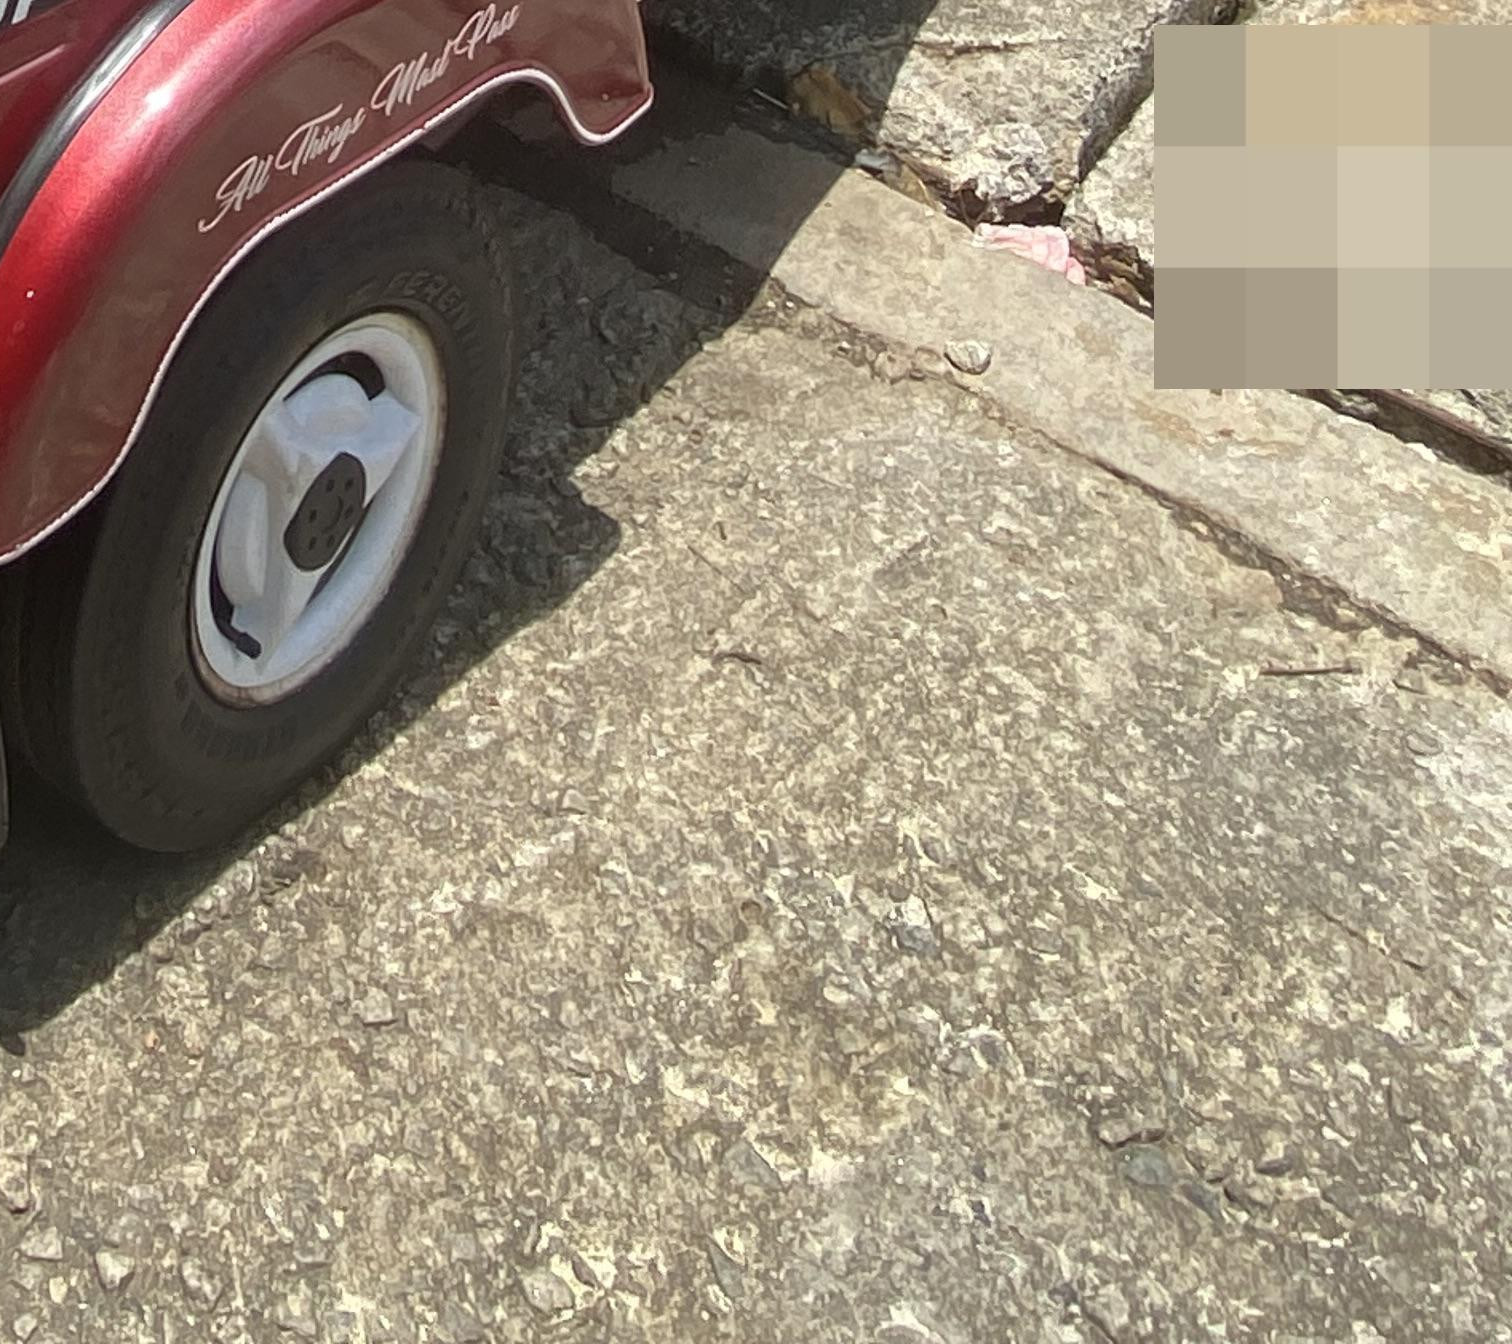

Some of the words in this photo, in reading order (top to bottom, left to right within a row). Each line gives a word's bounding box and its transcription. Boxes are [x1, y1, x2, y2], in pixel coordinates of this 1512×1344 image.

[198, 154, 274, 233] All
[274, 102, 366, 176] Things
[451, 2, 521, 61] Pass
